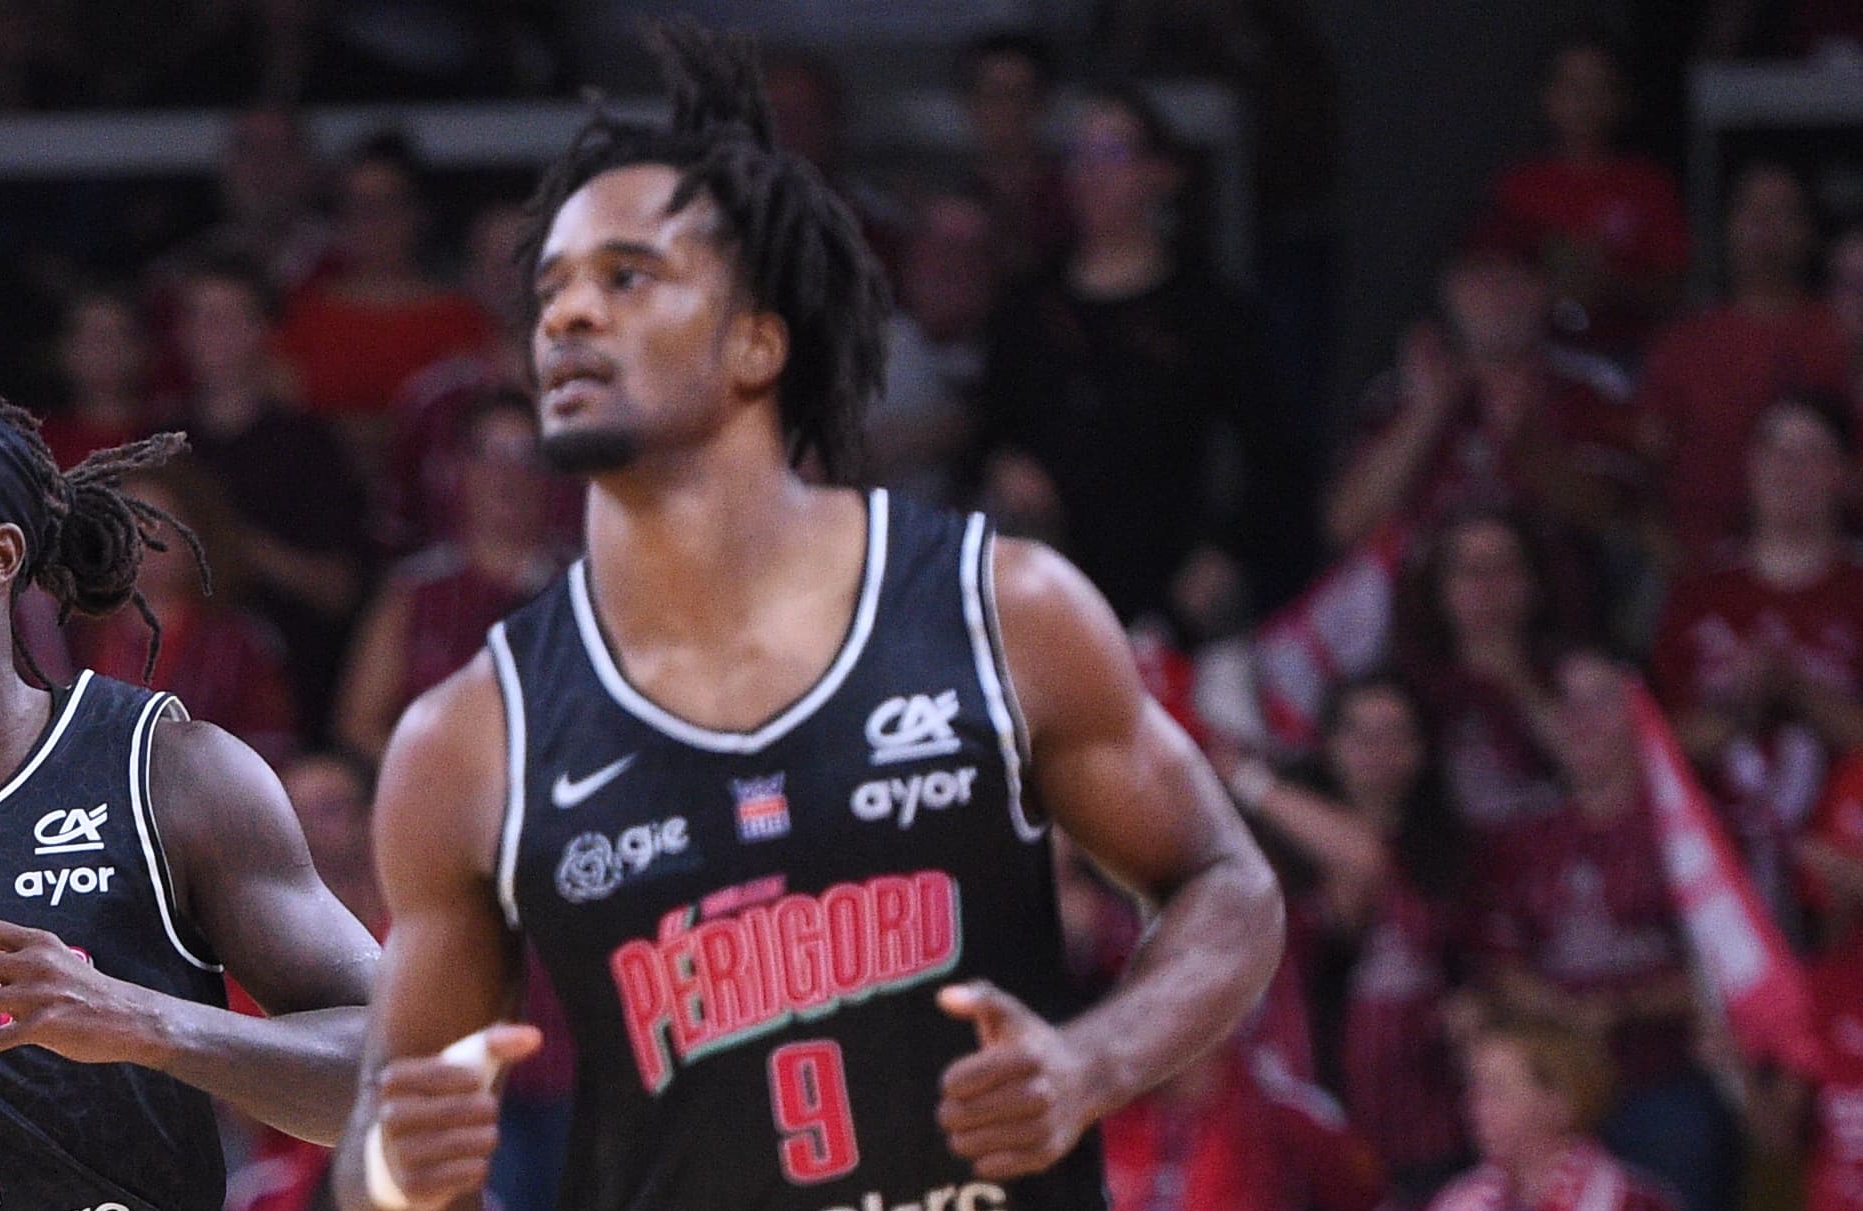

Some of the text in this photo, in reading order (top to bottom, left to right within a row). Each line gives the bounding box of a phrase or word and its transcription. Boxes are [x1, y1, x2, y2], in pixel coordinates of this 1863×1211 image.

[849, 766, 977, 830] ayor
[617, 815, 690, 874] gie
[14, 866, 115, 906] ayor
[611, 869, 963, 1094] PÉRIGORD
[766, 1038, 861, 1185] 9
